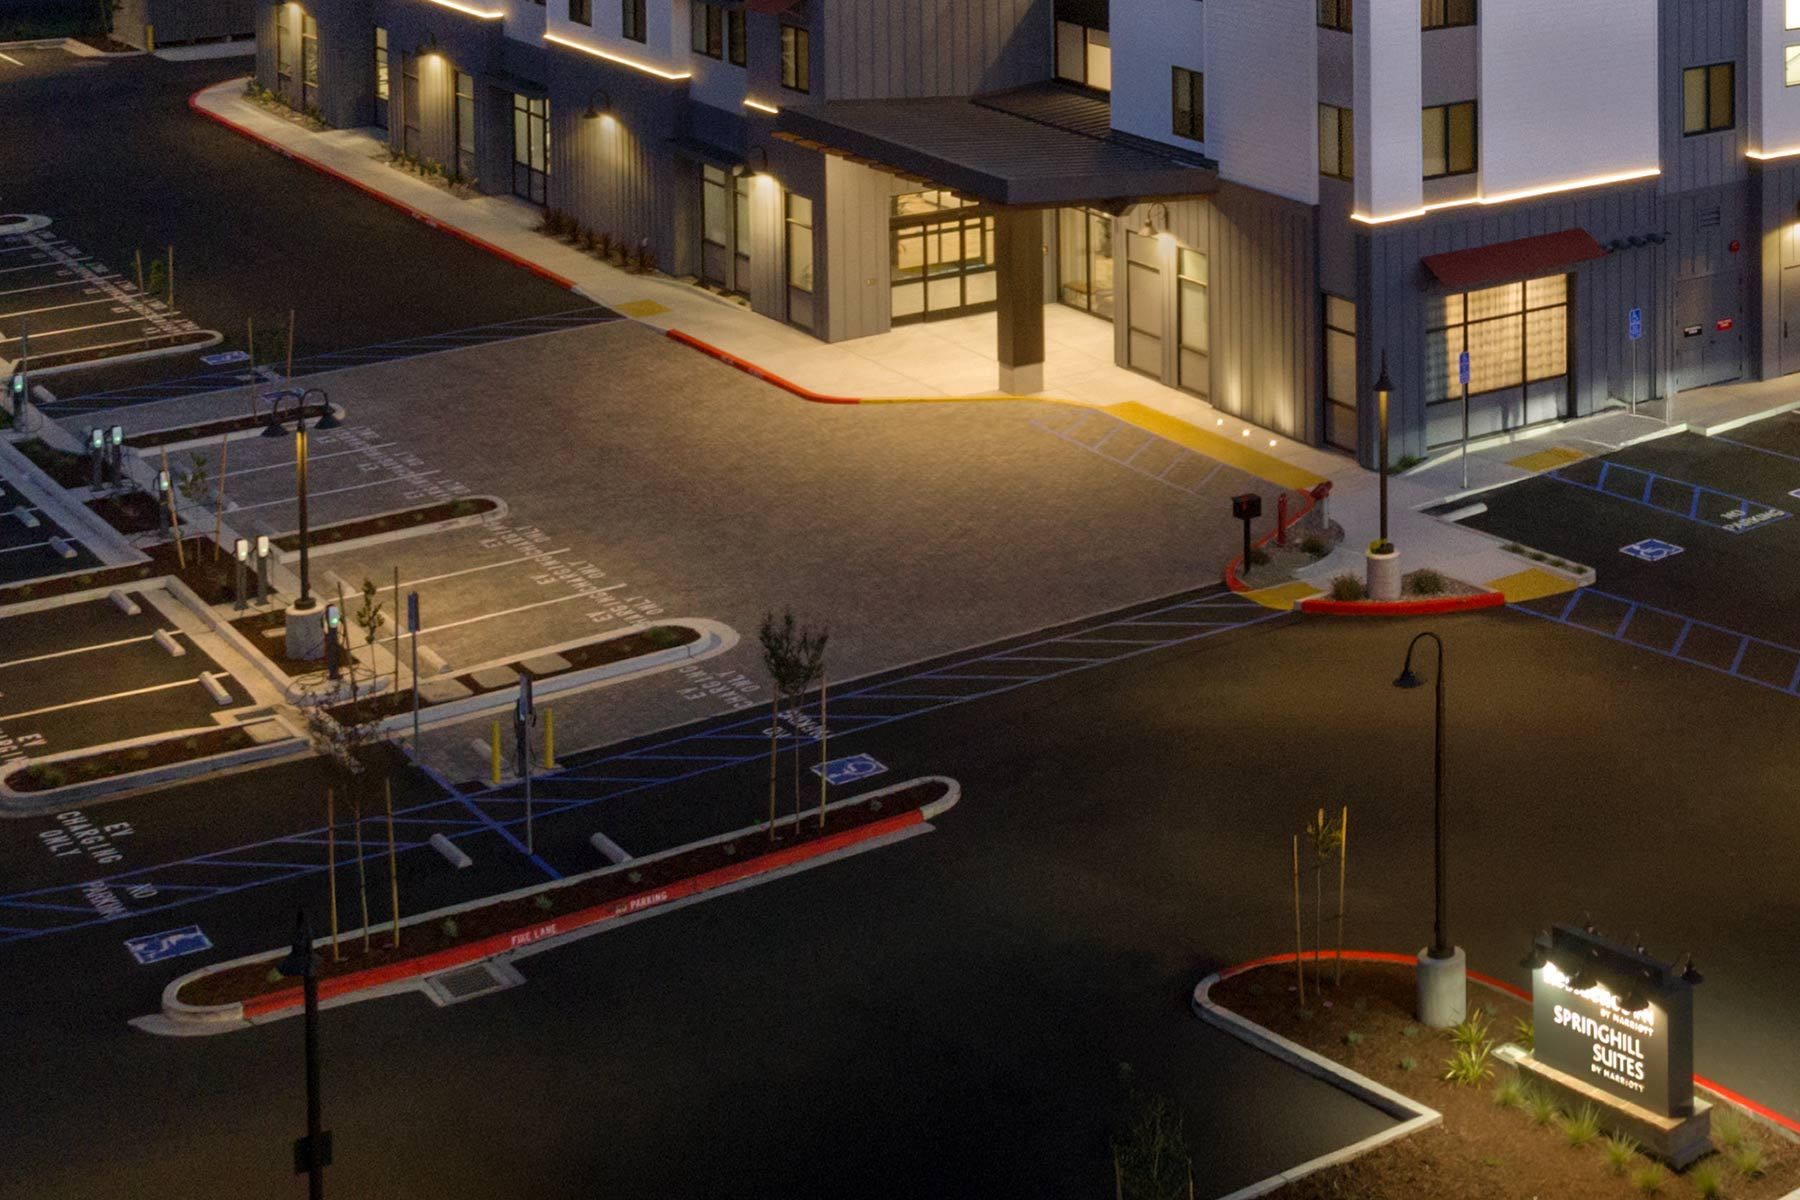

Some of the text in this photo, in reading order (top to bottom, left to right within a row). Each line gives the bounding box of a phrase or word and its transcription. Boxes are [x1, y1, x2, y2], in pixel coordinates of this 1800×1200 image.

[38, 829, 82, 857] ONLY
[56, 810, 123, 864] CHARGING
[103, 821, 136, 838] EV
[630, 891, 668, 910] PARKING
[511, 923, 557, 946] FIRE LANE
[1553, 1004, 1644, 1060] SPRINGHILL
[1613, 1011, 1654, 1037] MARRIOTT
[1592, 1043, 1645, 1080] SUITES
[1591, 1063, 1645, 1093] BY MARRIOTT
